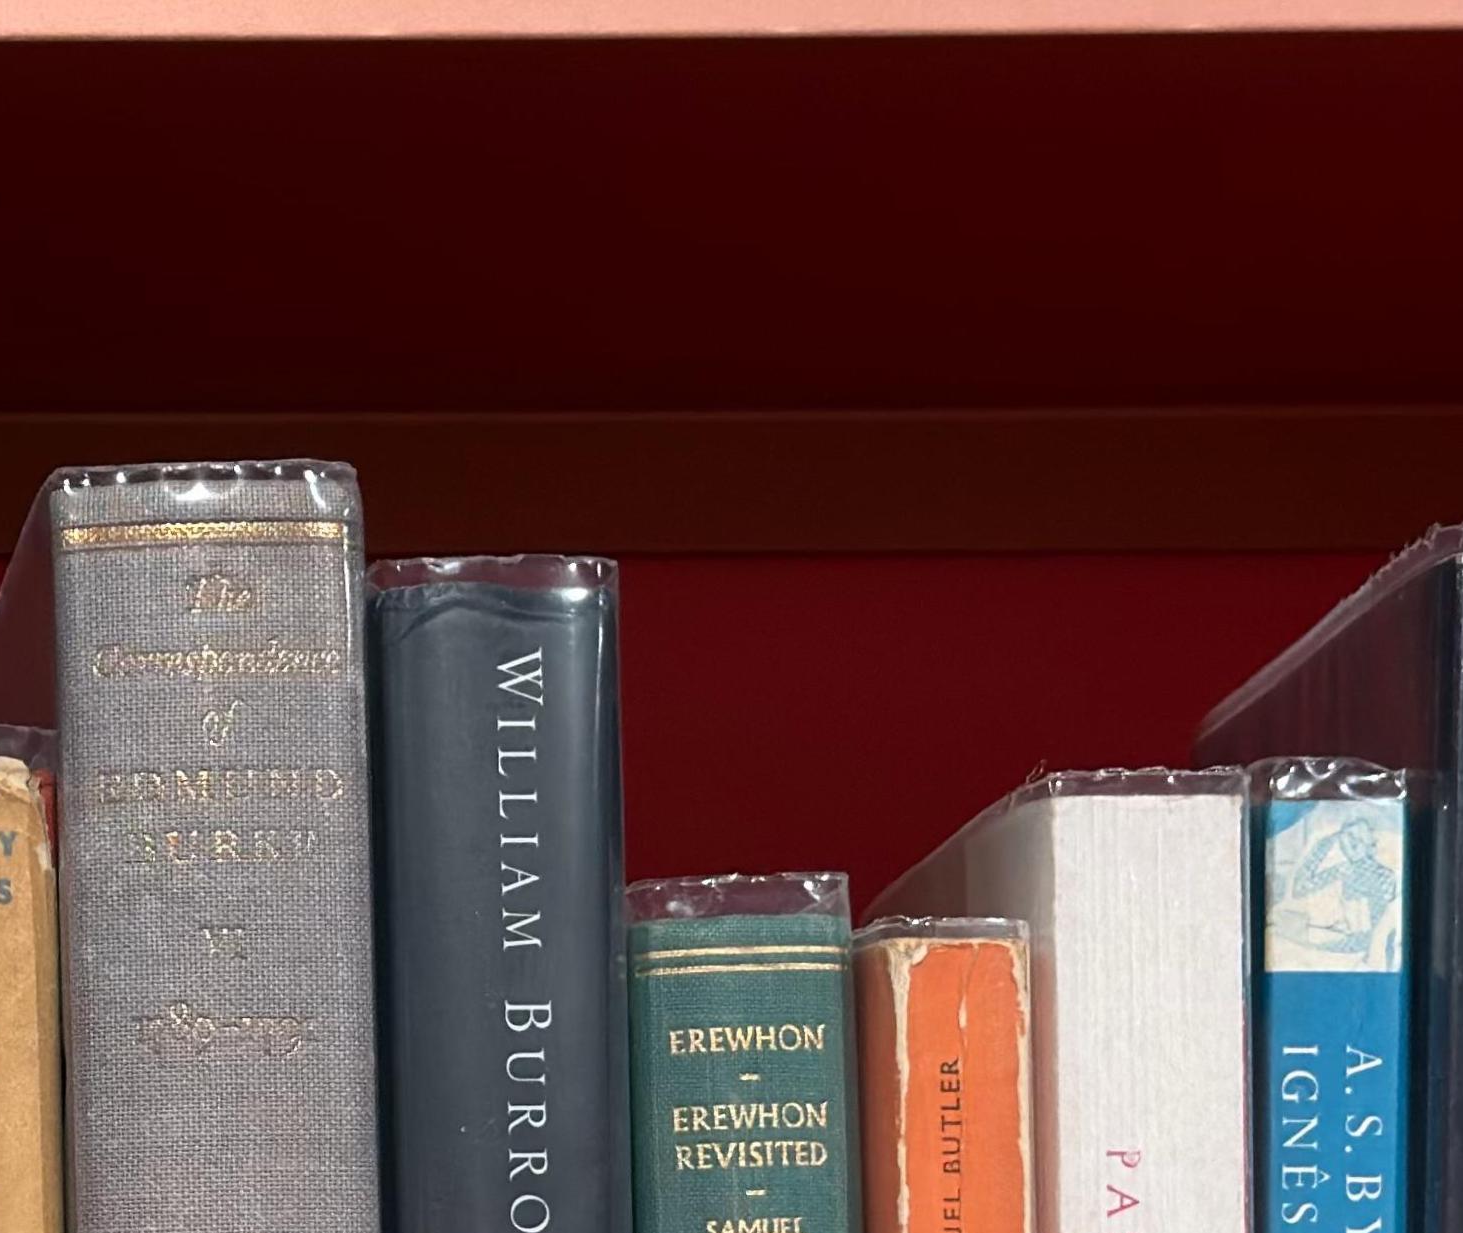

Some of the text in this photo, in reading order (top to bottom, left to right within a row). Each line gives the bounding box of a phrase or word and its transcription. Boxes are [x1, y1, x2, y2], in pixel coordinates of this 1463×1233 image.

[496, 646, 544, 951] WILLIAM
[669, 1023, 826, 1055] EREWHON
[672, 1101, 829, 1133] EREWHON
[939, 1056, 963, 1174] BUTLER
[1280, 1044, 1332, 1226] IGNÊS
[675, 1140, 829, 1171] REVISITED
